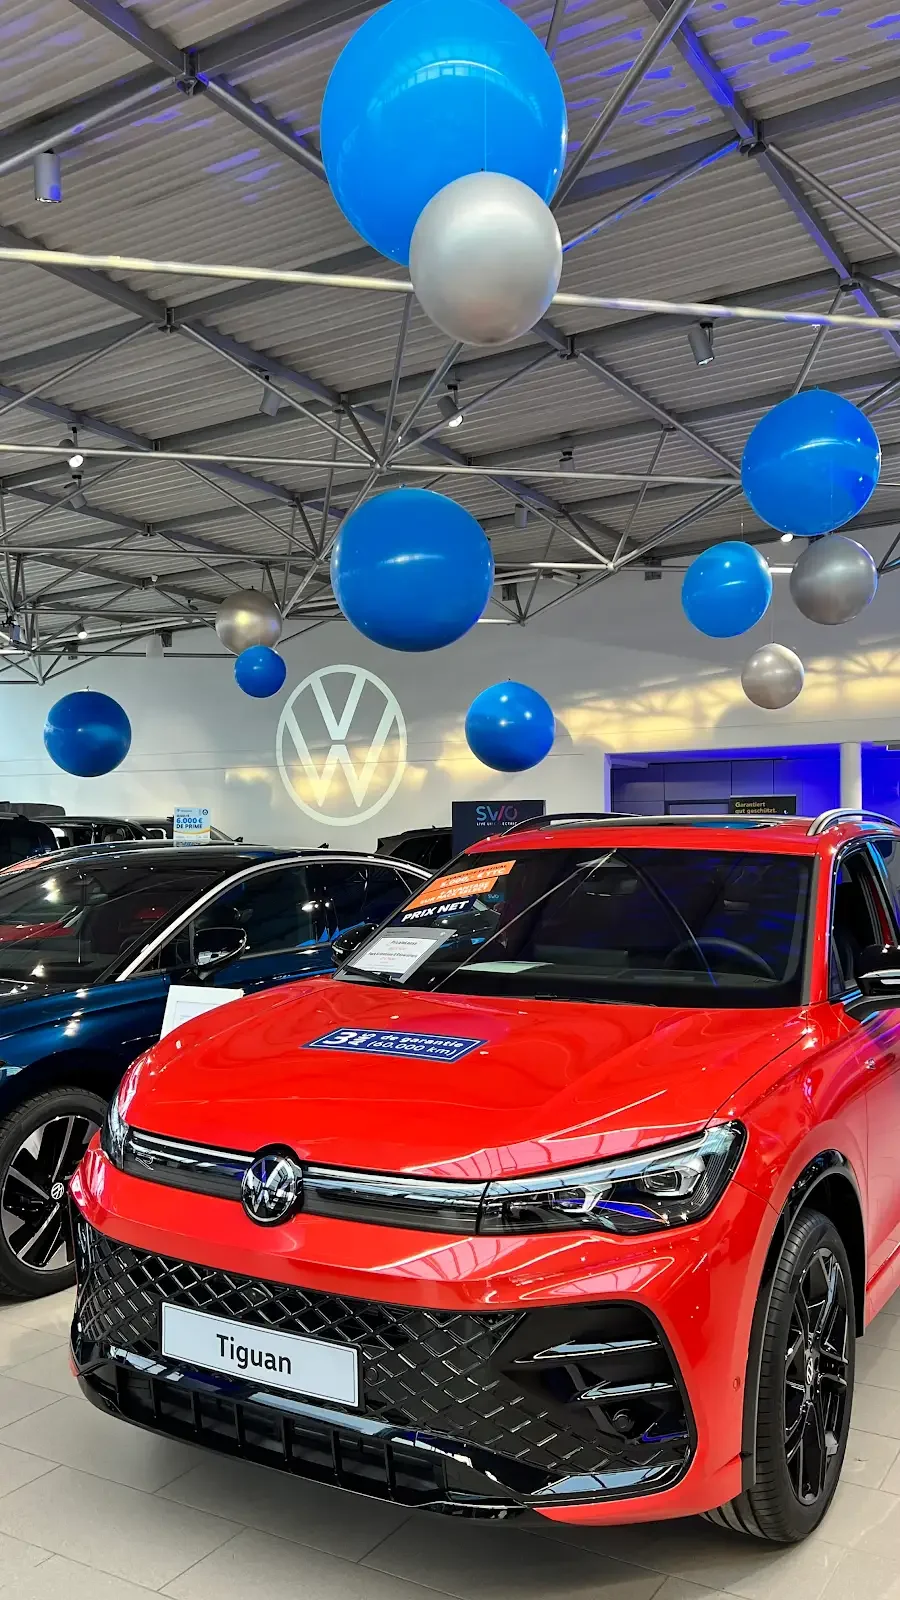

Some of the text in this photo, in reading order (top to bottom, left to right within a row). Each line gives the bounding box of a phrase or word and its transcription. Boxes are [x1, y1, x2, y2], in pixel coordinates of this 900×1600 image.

[401, 900, 469, 922] PRIX NET
[323, 1031, 358, 1045] 3
[403, 1037, 463, 1048] garantie
[366, 1040, 457, 1056] (60.000 km)
[216, 1333, 292, 1375] Tiguan
